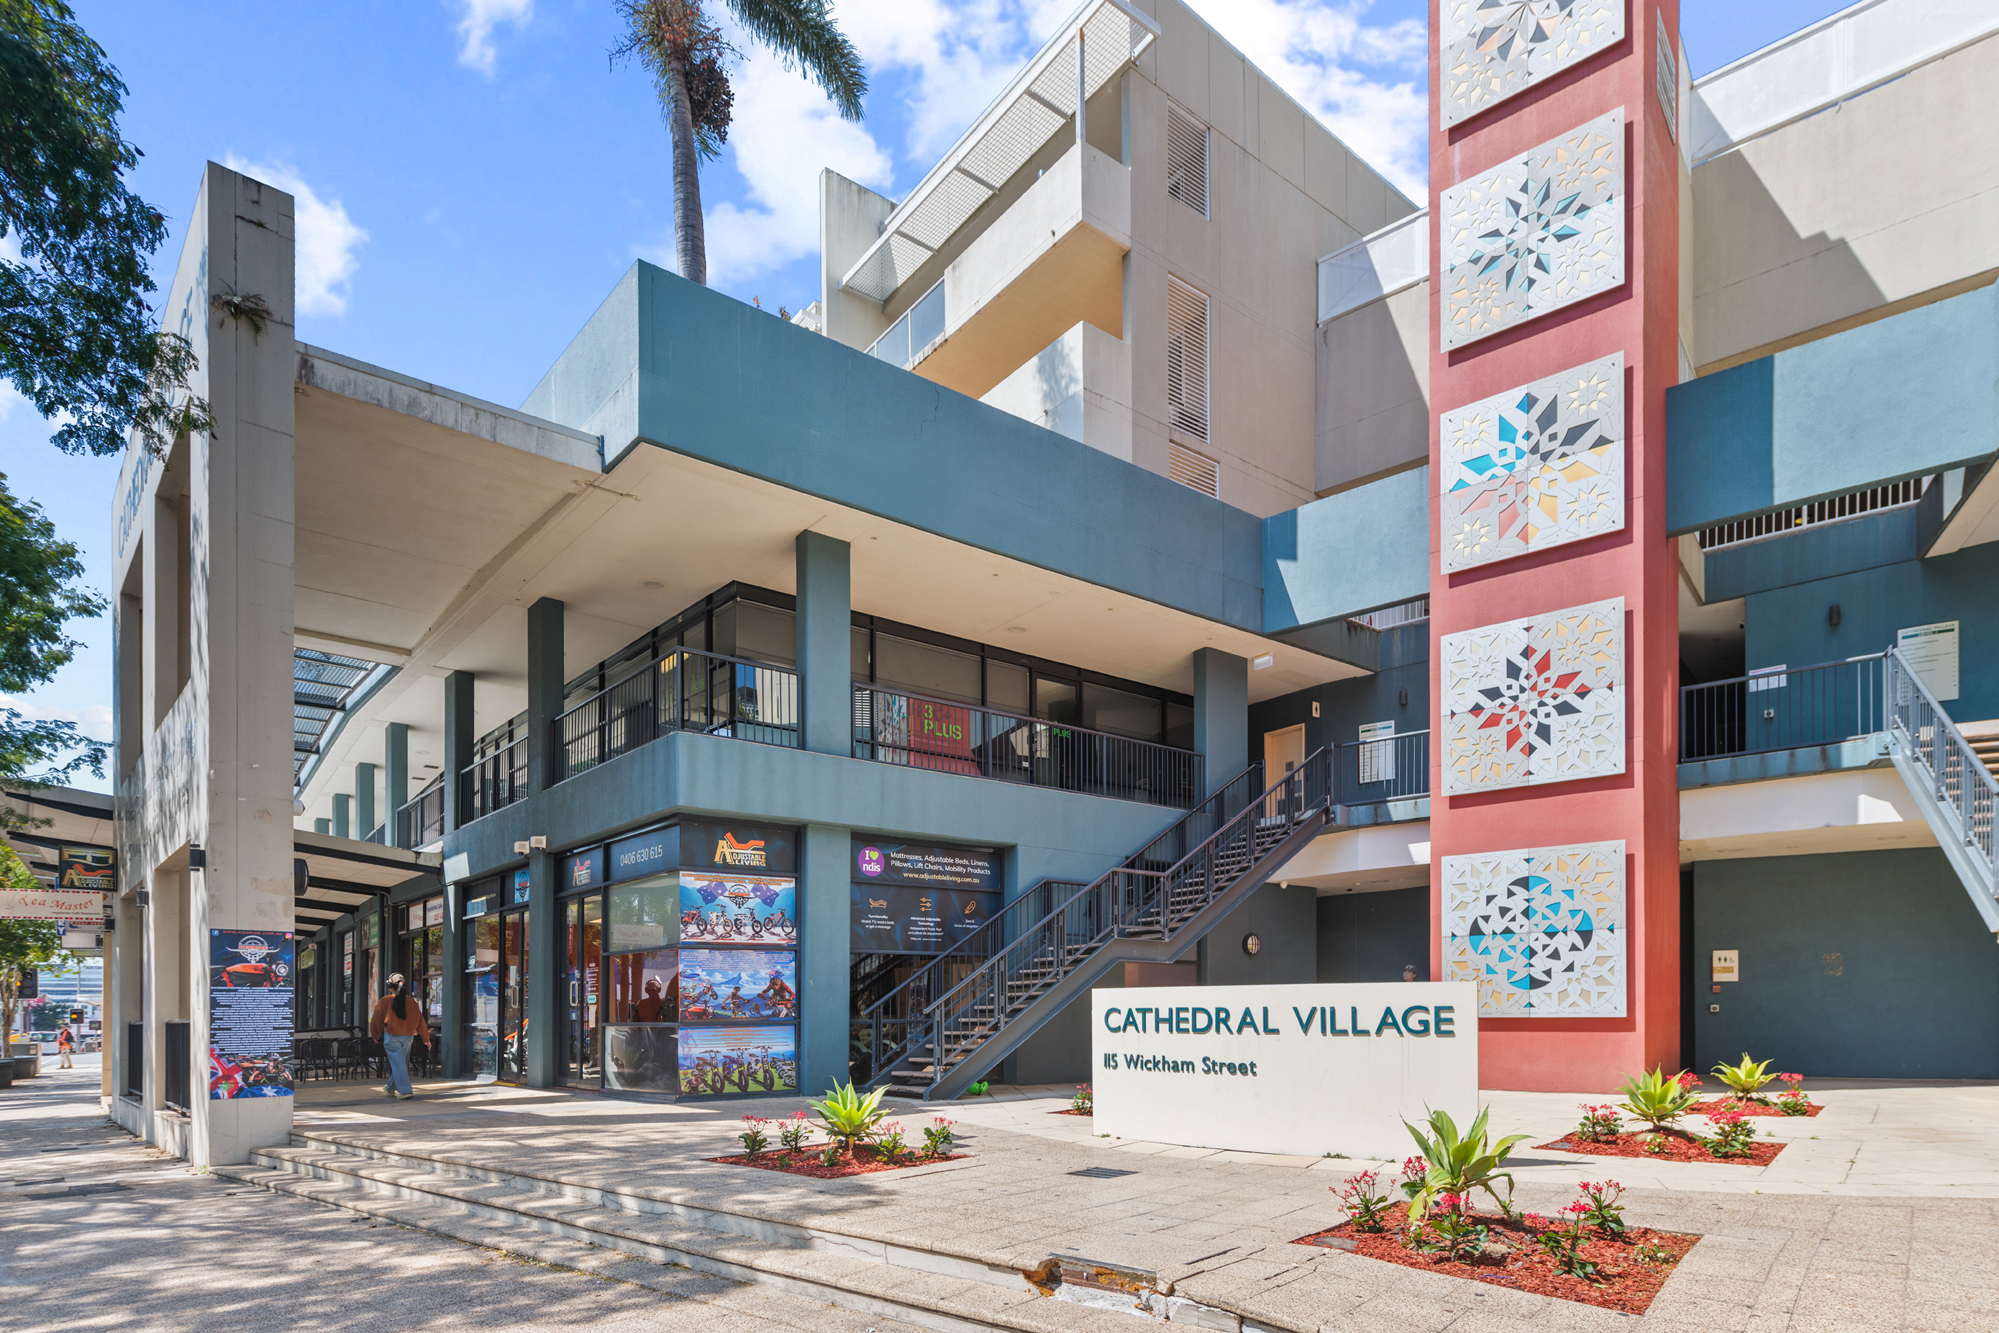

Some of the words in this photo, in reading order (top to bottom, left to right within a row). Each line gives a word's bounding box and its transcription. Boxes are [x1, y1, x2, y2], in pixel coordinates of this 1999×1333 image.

[924, 704, 933, 719] 3
[924, 719, 962, 740] PLUS
[620, 852, 636, 867] 0406
[637, 848, 649, 862] 630
[650, 845, 662, 860] 615
[735, 859, 766, 867] LIVING
[890, 852, 923, 861] Mattresses,
[924, 855, 954, 864] Adjustable
[955, 857, 970, 865] Beds,
[970, 859, 989, 867] Linens,
[863, 862, 881, 872] ndis
[890, 860, 913, 868] Pillows,
[925, 863, 944, 871] Chairs,
[945, 865, 966, 874] Mobility
[967, 867, 991, 875] Products
[903, 872, 980, 883] www.adjustableliving.com.au
[18, 895, 47, 906] Tea
[49, 898, 94, 911] Master
[1104, 1007, 1280, 1035] CATHEDRAL
[1292, 1005, 1455, 1037] VILLAGE
[1104, 1053, 1118, 1069] 115
[1124, 1054, 1196, 1073] Wickham
[1202, 1056, 1257, 1076] Street
